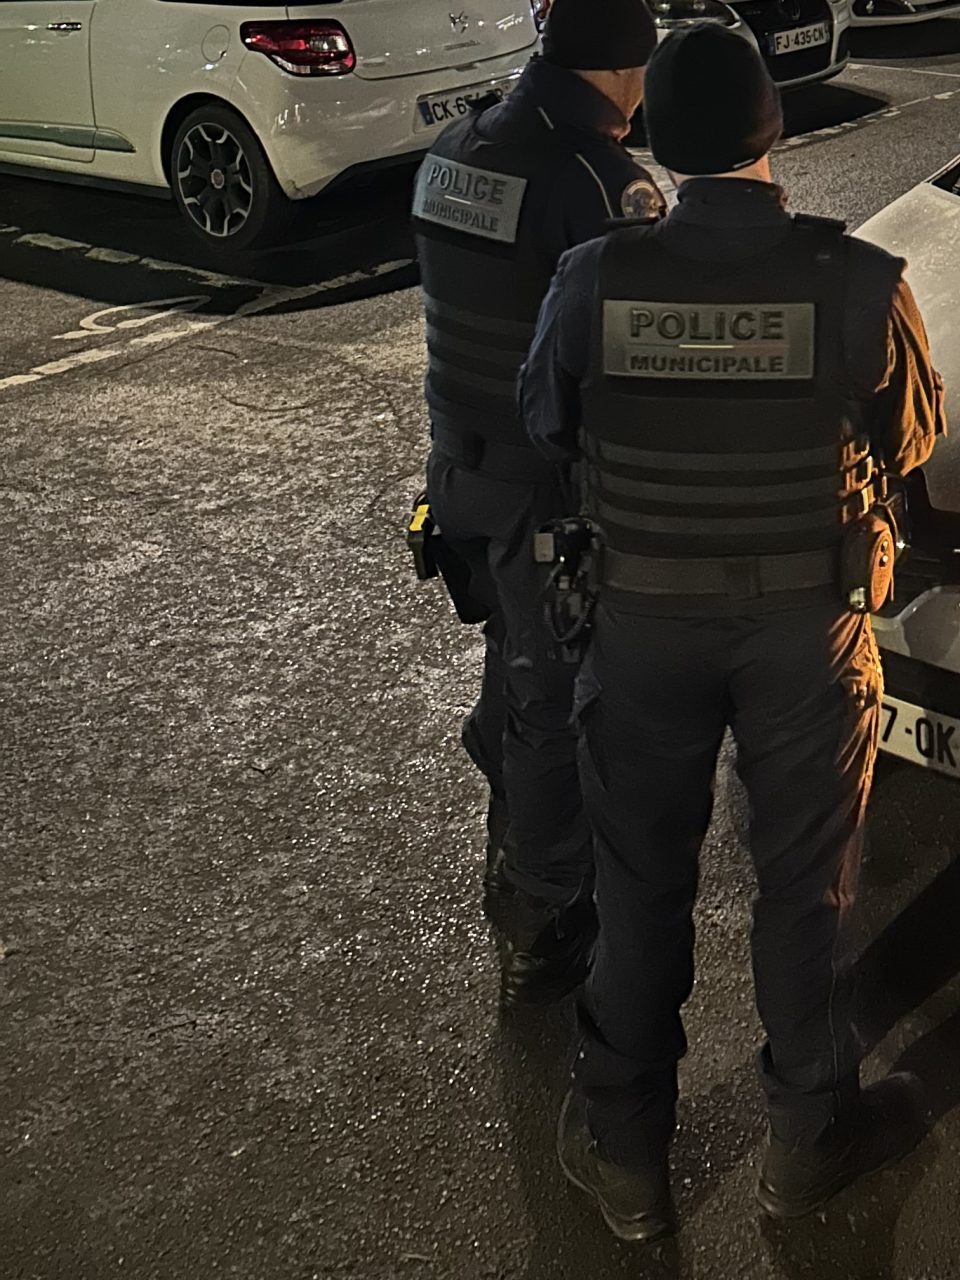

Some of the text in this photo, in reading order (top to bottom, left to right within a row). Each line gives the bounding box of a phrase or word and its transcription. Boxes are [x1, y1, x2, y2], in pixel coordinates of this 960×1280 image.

[427, 163, 508, 205] POLICE
[422, 198, 499, 232] MUNICIPALE
[629, 306, 785, 341] POLICE
[629, 354, 784, 373] MUNICIPALE
